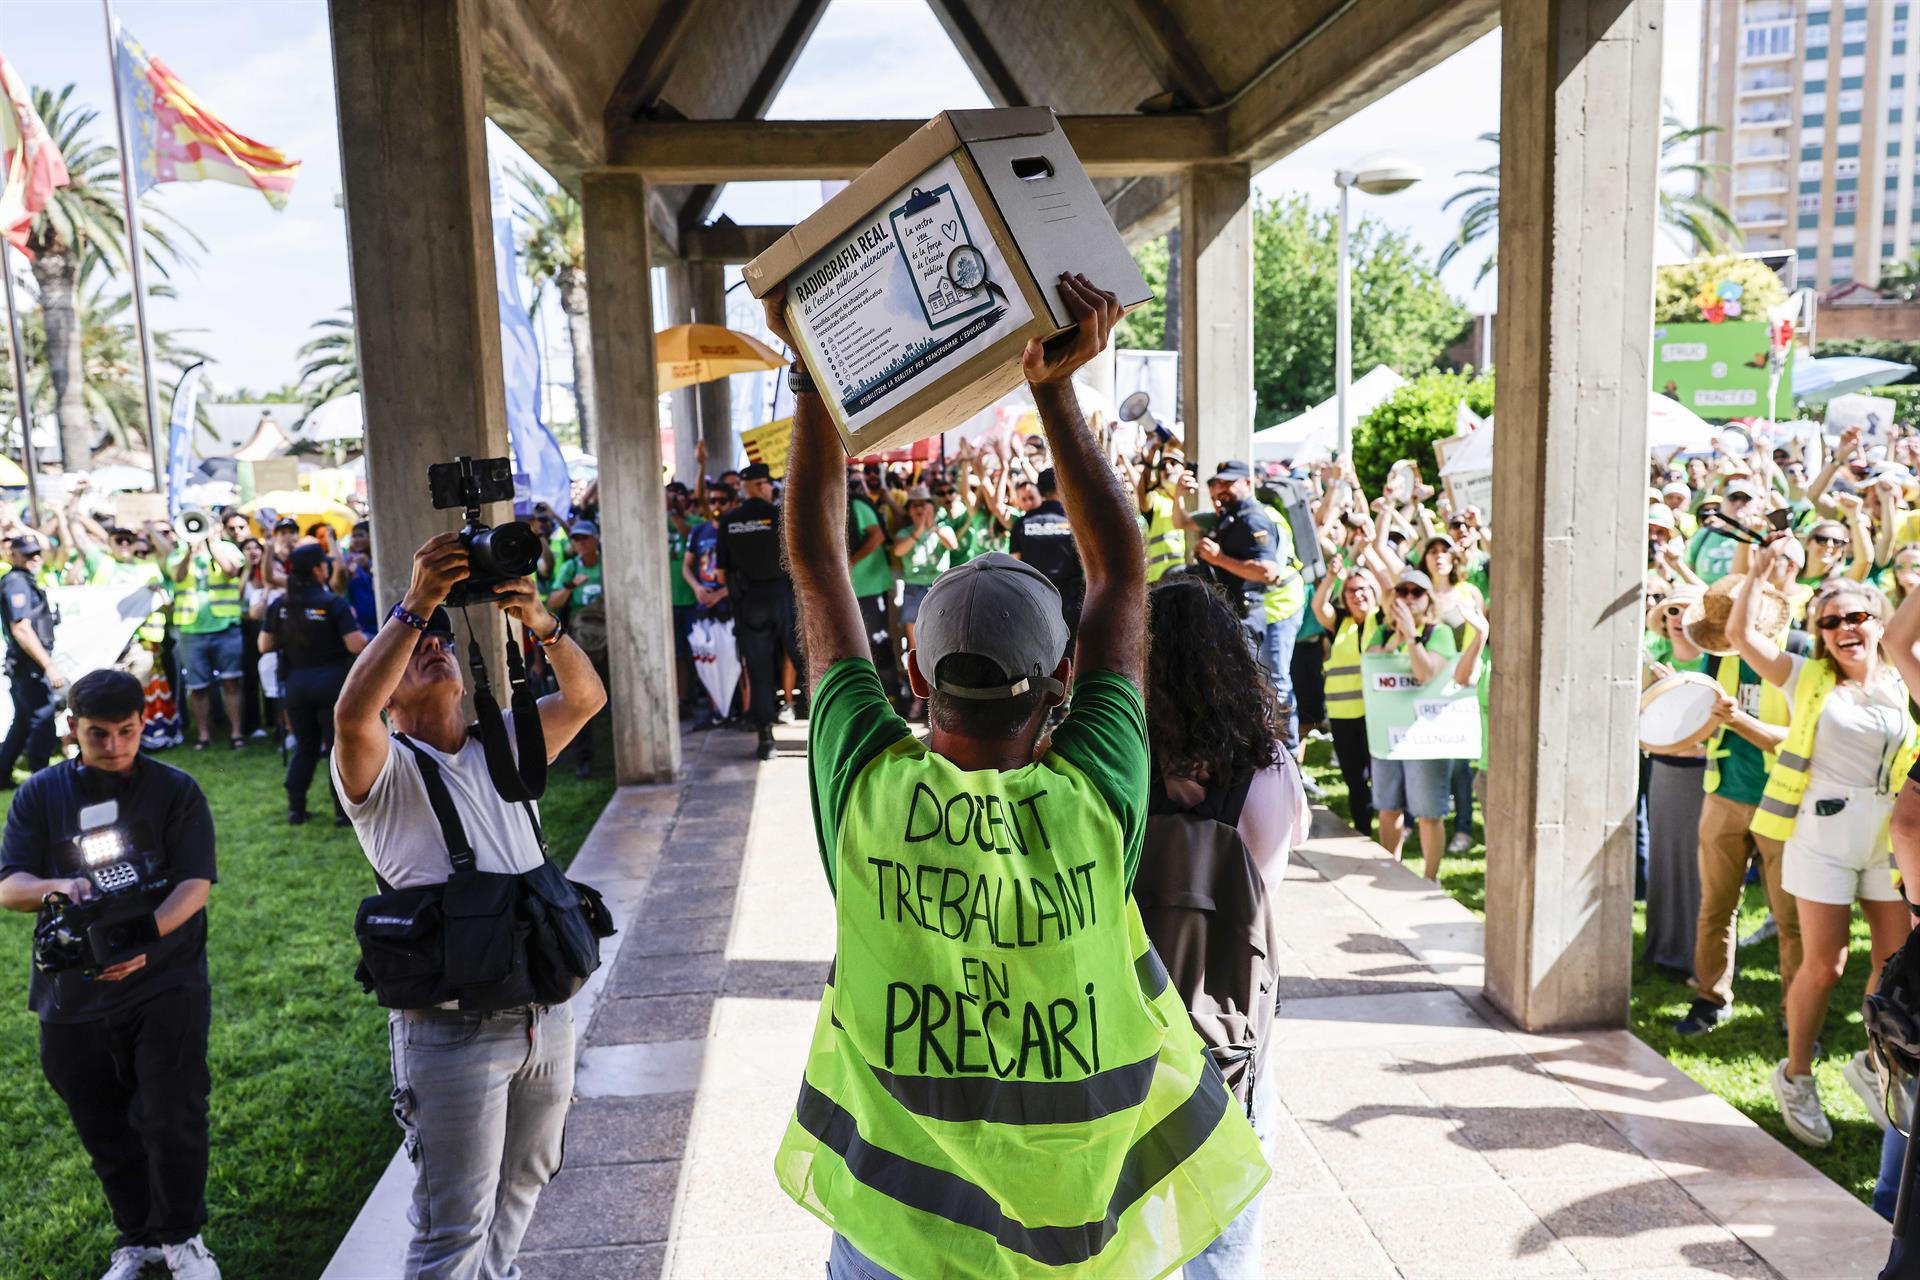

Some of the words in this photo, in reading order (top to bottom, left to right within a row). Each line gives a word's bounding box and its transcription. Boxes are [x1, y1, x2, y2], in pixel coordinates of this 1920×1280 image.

[904, 227, 914, 237] La
[914, 217, 934, 231] vostra
[916, 232, 928, 242] veu
[918, 247, 926, 256] la
[926, 240, 943, 254] força
[795, 243, 861, 304] RADIOGRAFIA
[857, 222, 889, 254] REAL
[804, 303, 812, 316] de
[812, 286, 835, 309] l'escola
[836, 269, 859, 296] pública
[860, 241, 896, 272] valenciana
[917, 260, 924, 270] de
[924, 250, 945, 265] l'escola
[923, 264, 944, 281] pública
[811, 314, 831, 332] Recollida
[830, 306, 843, 319] urgent
[842, 301, 849, 310] de
[848, 288, 869, 307] situacions
[818, 319, 840, 337] necessitats
[839, 313, 848, 322] dels
[848, 302, 863, 316] centres
[862, 288, 883, 305] educatius
[859, 386, 888, 405] VISIBILITZEM
[894, 365, 915, 383] REALITAT
[915, 360, 924, 370] PER
[925, 337, 959, 363] TRANSFORMAR
[1379, 676, 1396, 688] NO
[904, 781, 1053, 856] DOCENT
[867, 856, 1099, 949] TREBALLANT
[961, 956, 1010, 1000] EN
